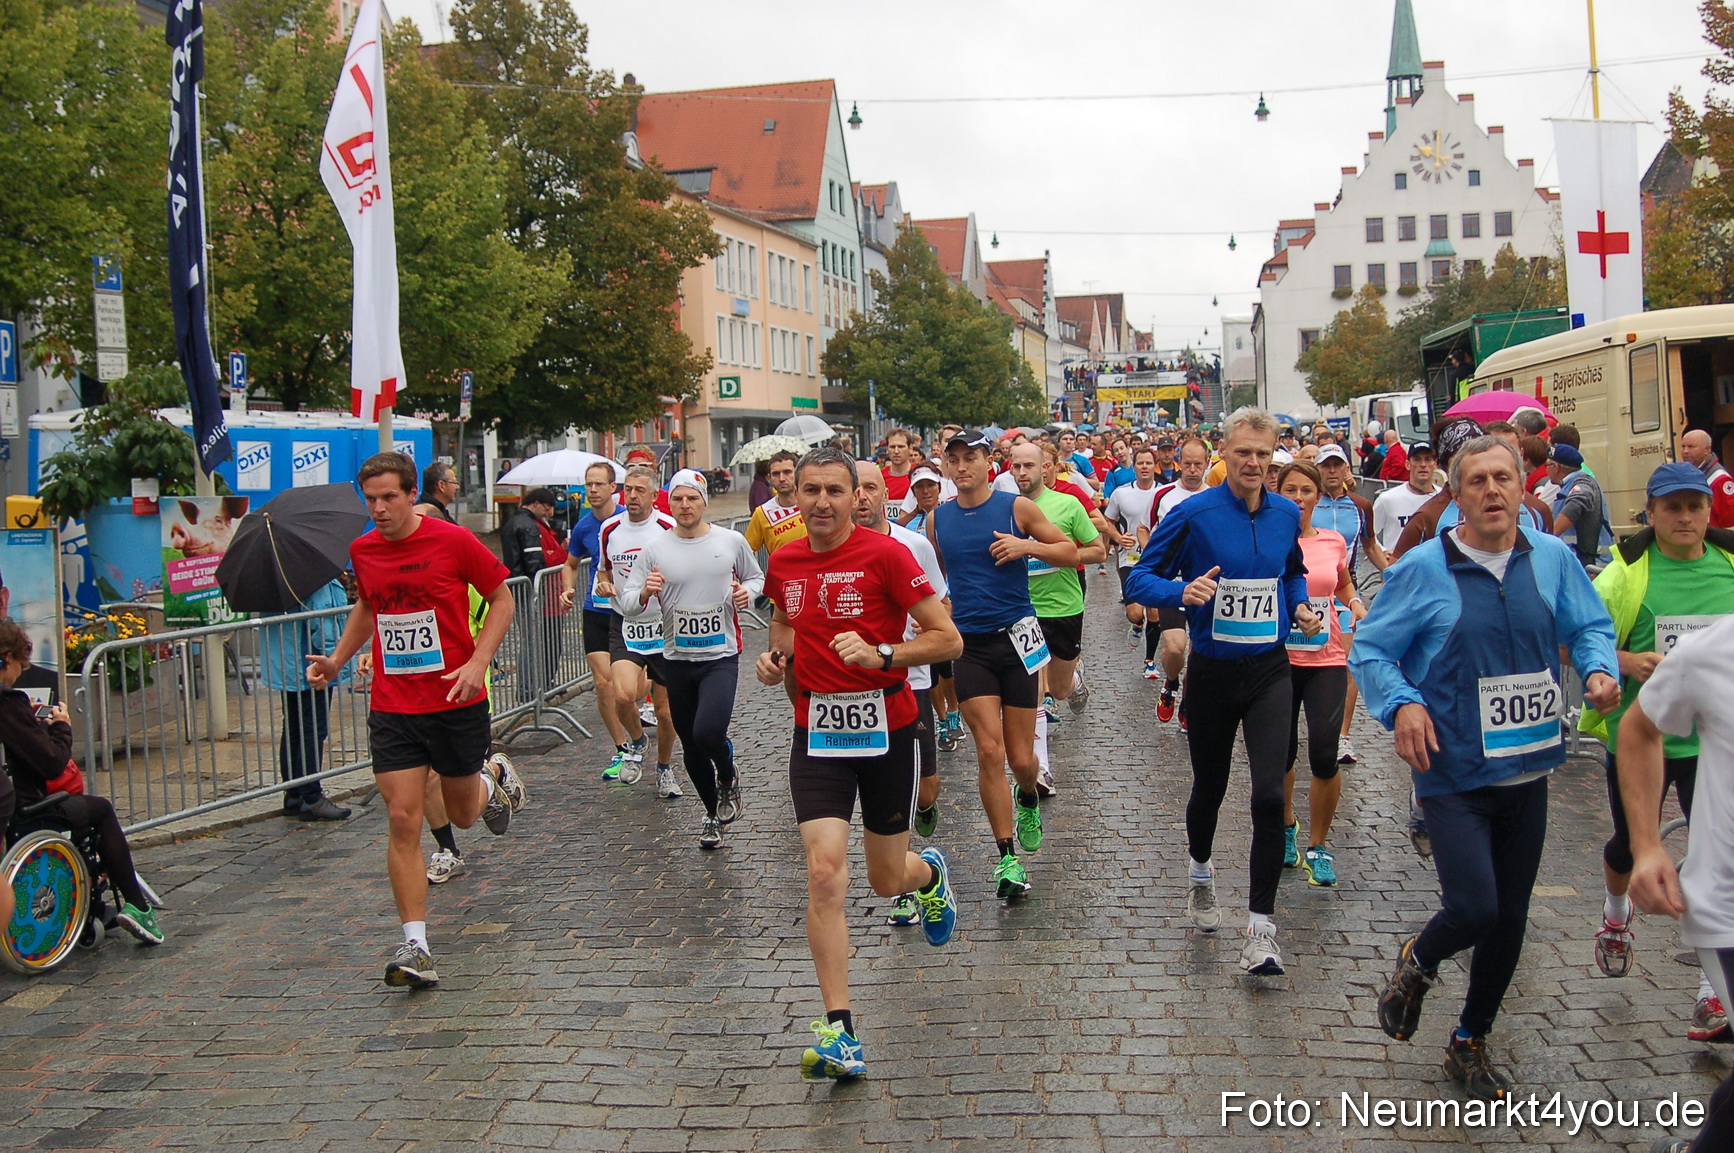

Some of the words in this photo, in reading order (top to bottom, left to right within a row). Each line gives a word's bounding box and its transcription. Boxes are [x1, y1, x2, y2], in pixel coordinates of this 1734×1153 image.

[1, 329, 11, 375] P
[232, 357, 243, 386] P
[463, 375, 471, 397] P
[1552, 365, 1603, 394] Bayerisches
[721, 379, 738, 396] D
[1126, 389, 1157, 399] START
[1552, 395, 1577, 415] Rotes
[1630, 444, 1660, 458] Bayerisches
[886, 506, 899, 518] 20
[773, 521, 797, 537] MAX
[612, 554, 638, 562] GERHA
[171, 569, 195, 581] BEIDE
[192, 576, 215, 587] GRÜN
[824, 571, 865, 579] NEUMARKTER
[1219, 584, 1241, 592] PARTL
[691, 608, 716, 616] Neumarkt
[1220, 594, 1273, 619] 3174
[208, 605, 244, 625] DU
[394, 618, 424, 627] Neumarkt
[678, 614, 721, 636] 2036
[1657, 623, 1685, 631] PARTL
[384, 626, 434, 652] 2573
[626, 624, 664, 640] 3014
[687, 638, 714, 646] Karsten
[1289, 634, 1311, 645] Birgit
[396, 656, 424, 666] Fabian
[1480, 684, 1511, 694] PARTL
[1512, 679, 1551, 691] Neumarkt
[811, 692, 832, 701] PARTL
[832, 692, 870, 701] Neumarkt
[1489, 688, 1557, 726] 3052
[815, 702, 879, 730] 2963
[825, 735, 871, 747] Reinhard
